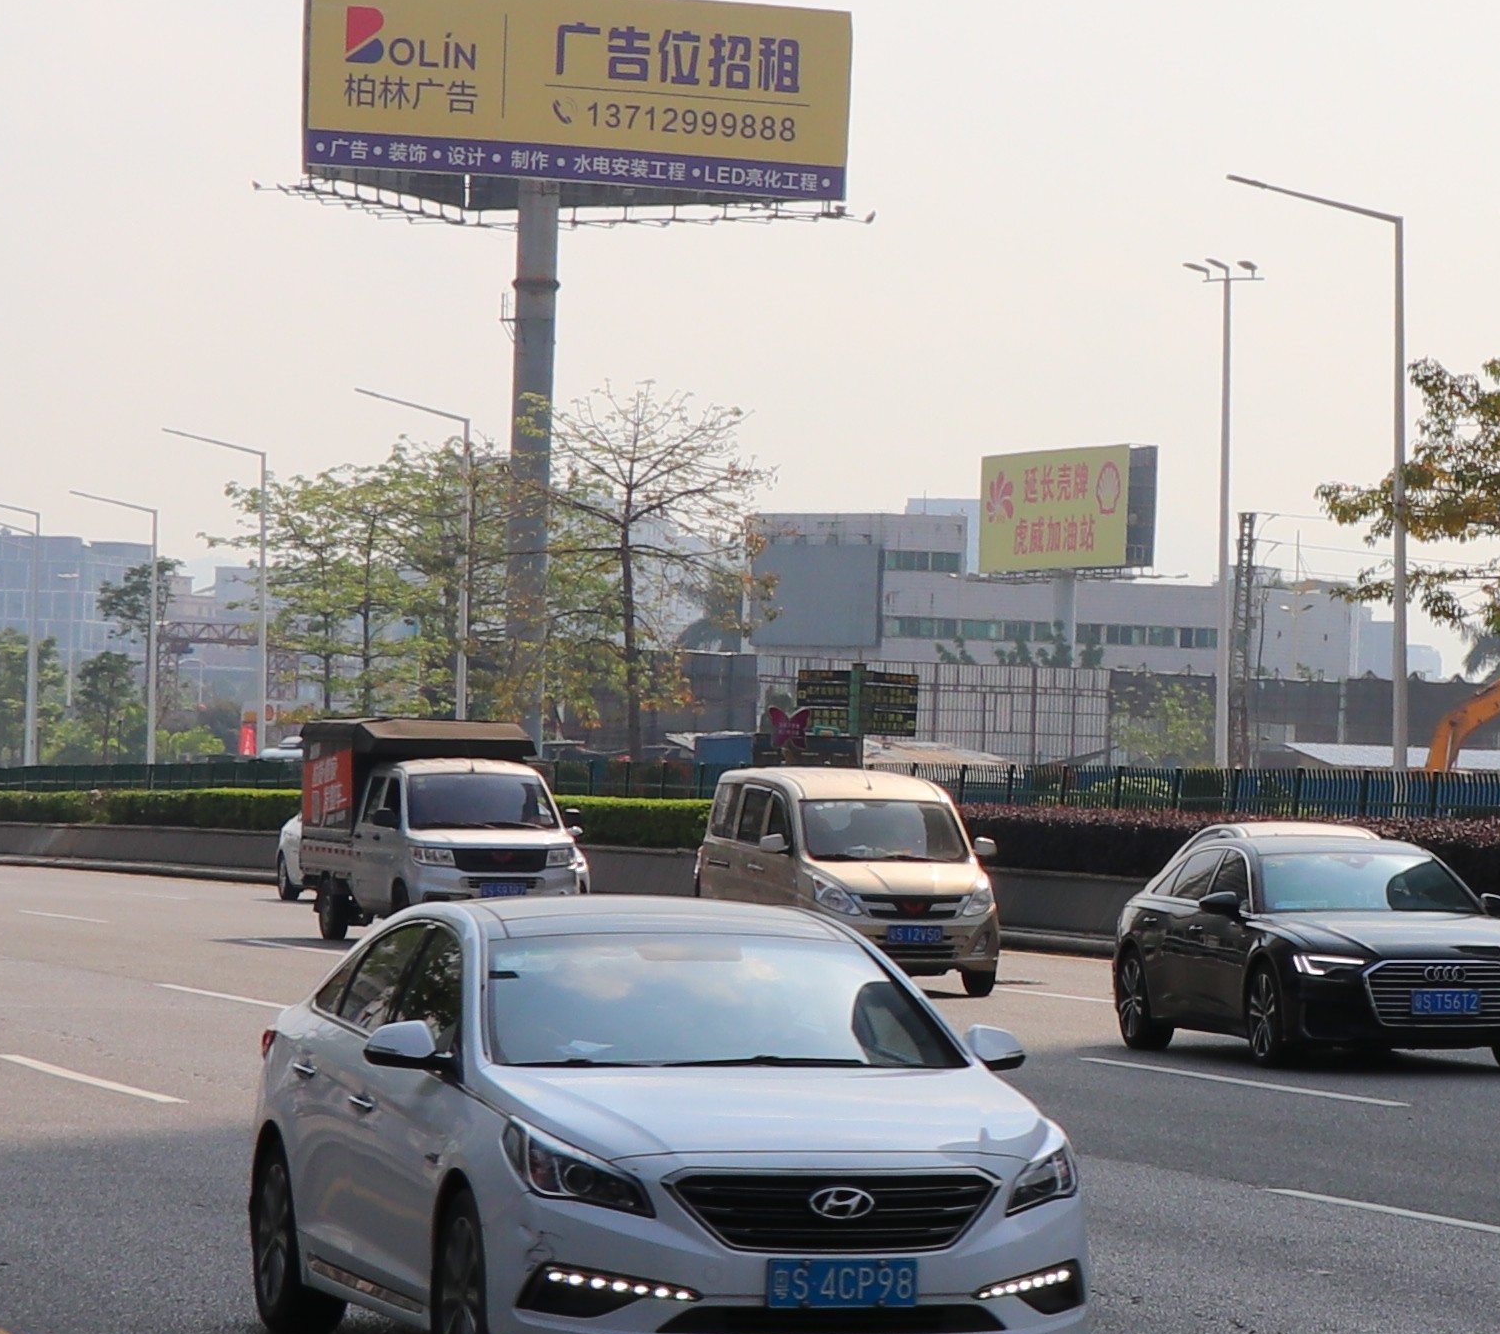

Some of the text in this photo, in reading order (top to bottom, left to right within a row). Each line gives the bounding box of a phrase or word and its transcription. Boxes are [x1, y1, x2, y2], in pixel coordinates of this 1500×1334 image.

[556, 22, 800, 93] 广告位招租
[344, 73, 478, 114] 柏林广告
[587, 103, 796, 142] 13712999888
[329, 139, 818, 191] 广告 装饰 设计 制作 水电安装工程 LED亮化工程
[1023, 464, 1089, 504] 延长壳牌
[1013, 515, 1096, 555] 虎威加油站
